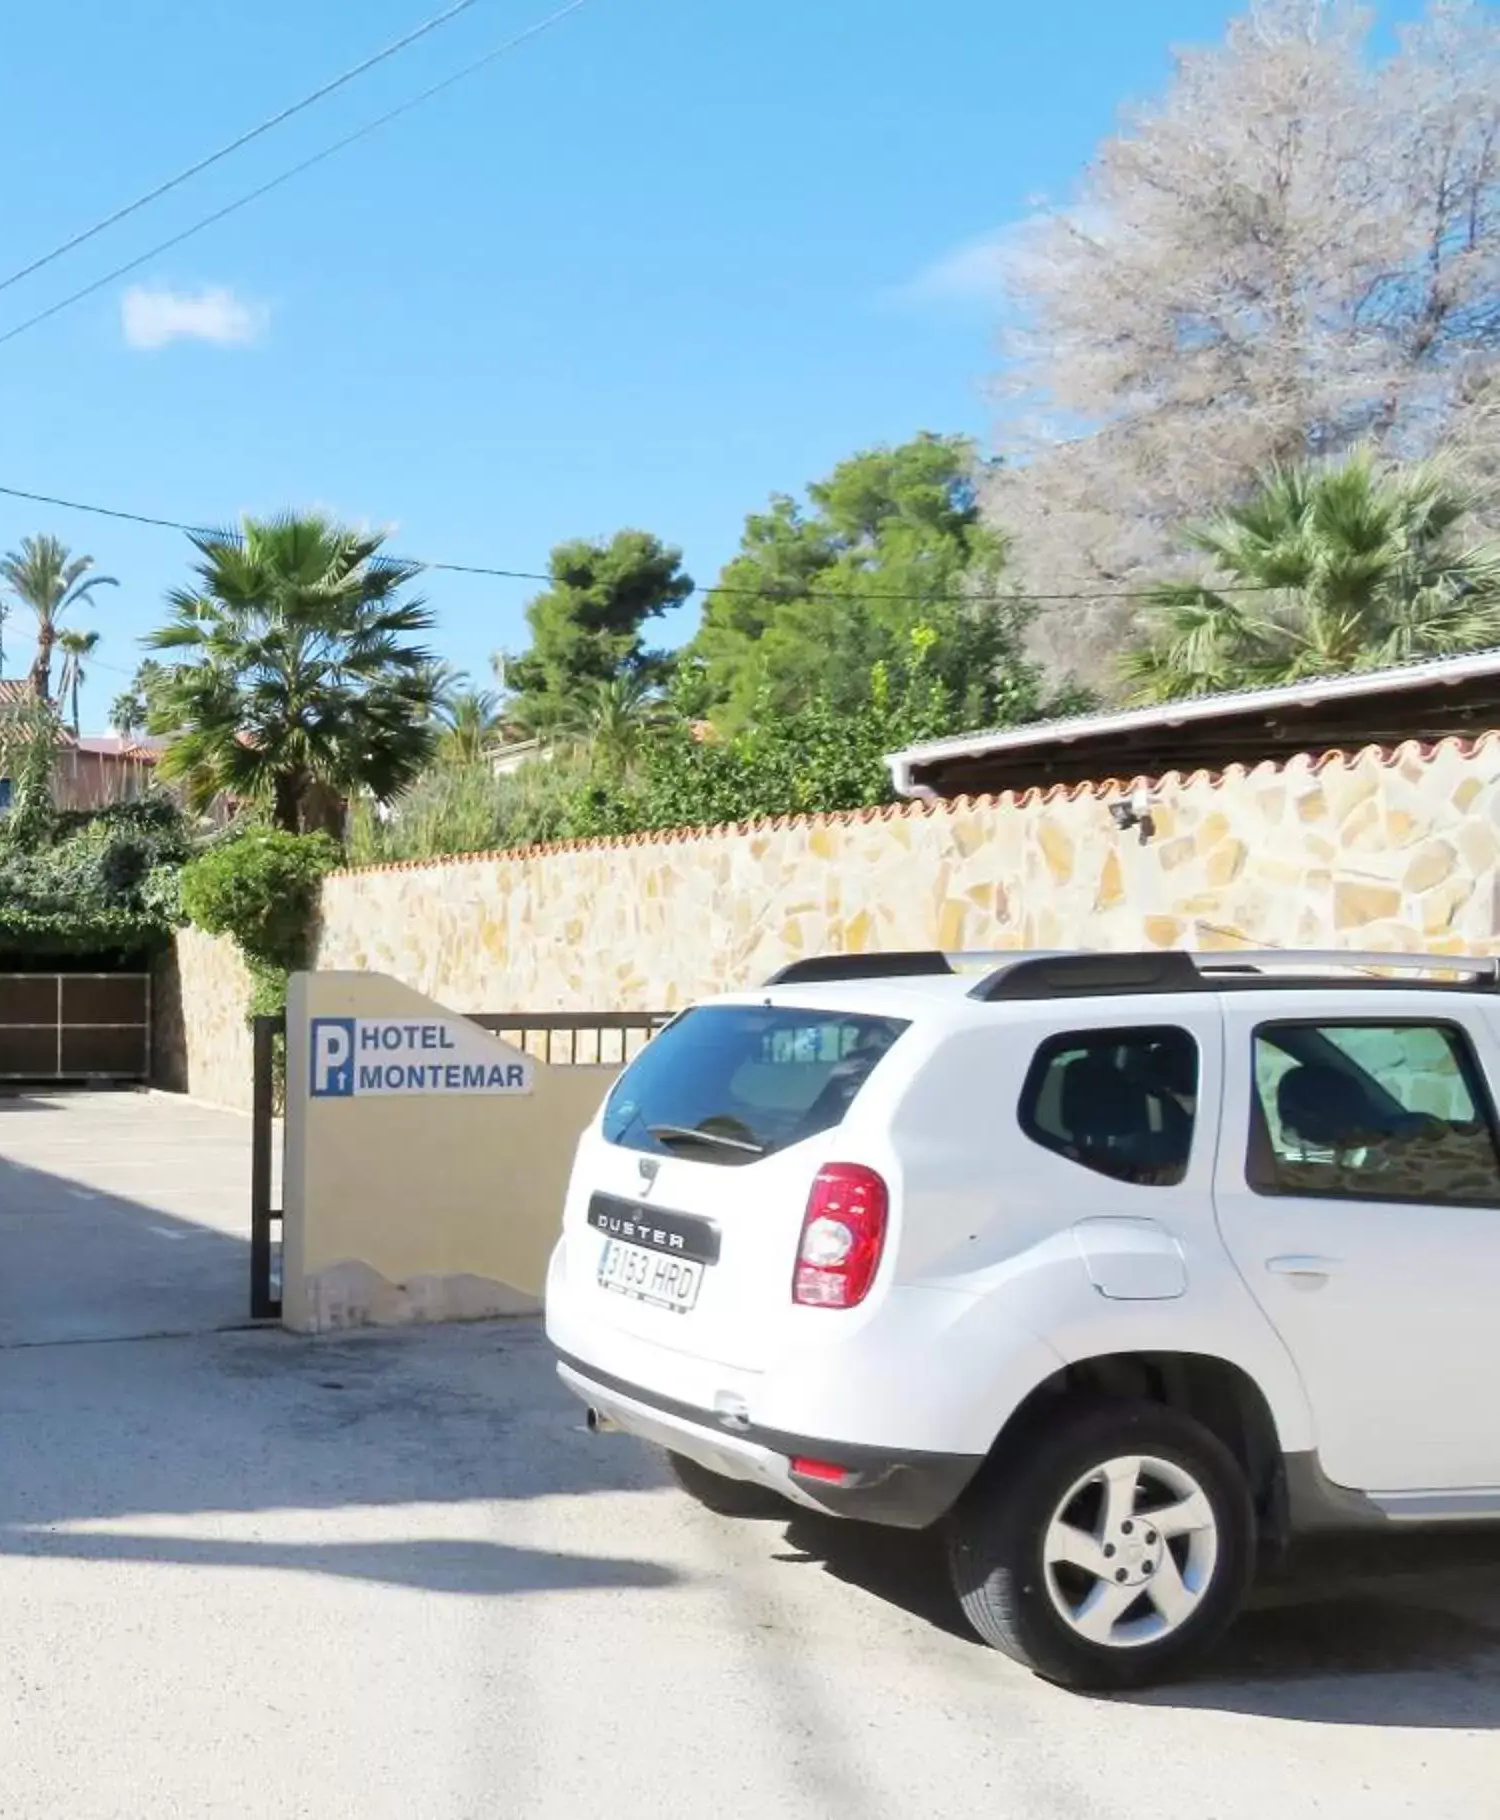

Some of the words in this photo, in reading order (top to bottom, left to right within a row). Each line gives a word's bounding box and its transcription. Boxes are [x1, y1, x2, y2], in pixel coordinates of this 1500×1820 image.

[360, 1026, 455, 1050] HOTEL
[315, 1024, 350, 1090] P
[359, 1065, 524, 1089] MONTEMAR
[597, 1214, 685, 1248] DUSTER
[651, 1259, 694, 1299] HRD
